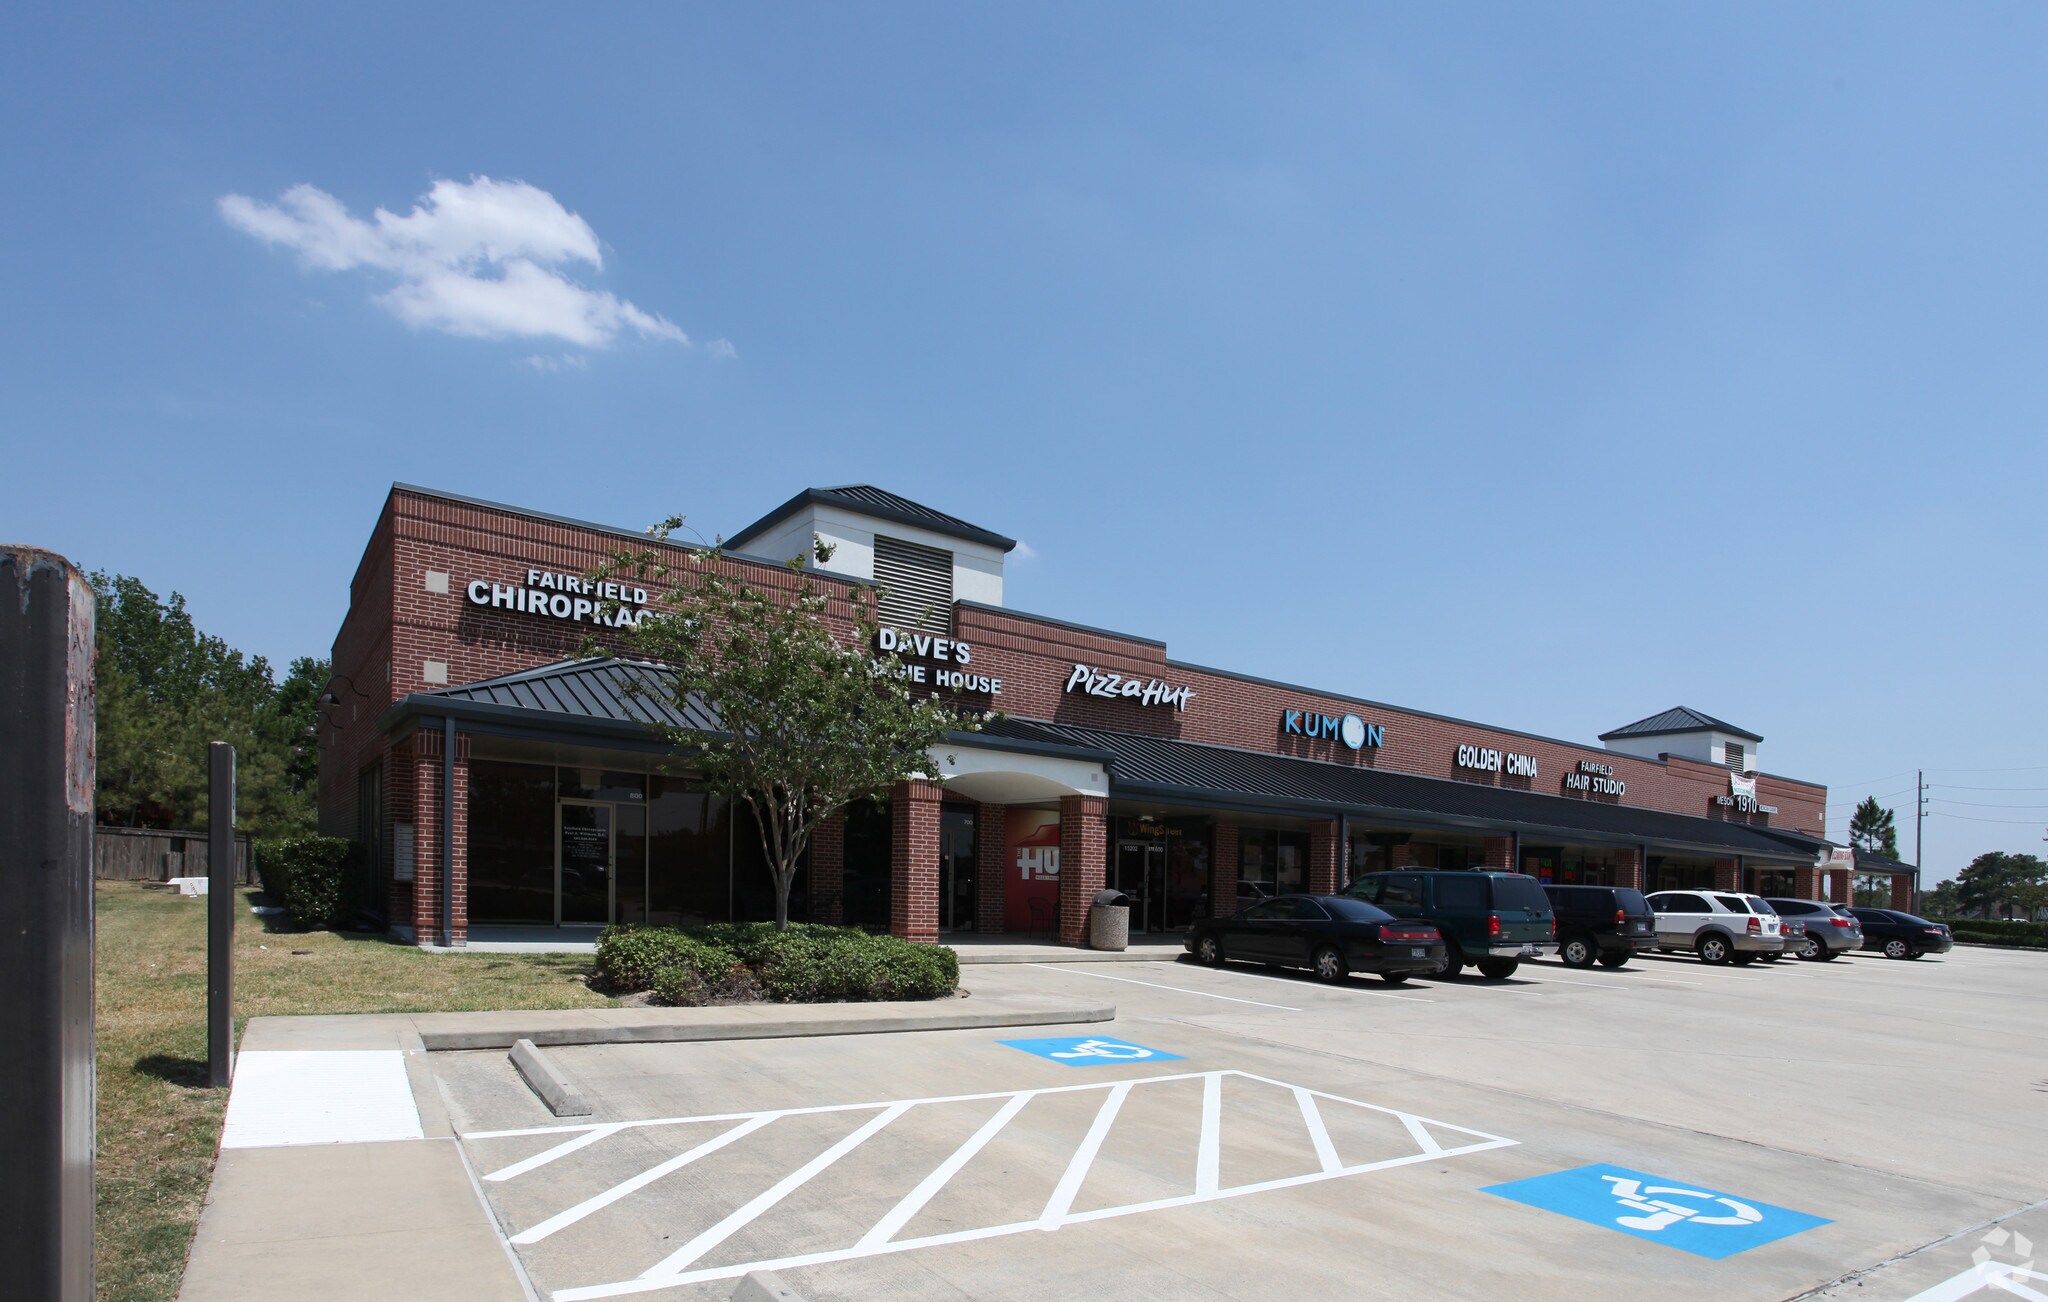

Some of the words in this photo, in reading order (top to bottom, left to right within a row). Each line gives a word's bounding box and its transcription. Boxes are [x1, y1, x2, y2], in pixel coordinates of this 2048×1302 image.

[526, 569, 648, 604] FAIRFIELD
[879, 627, 971, 664] DAVE'S
[936, 669, 1002, 695] HOUSE
[1285, 710, 1385, 749] KUMON
[1457, 744, 1502, 772] GOLDEN
[1507, 752, 1537, 777] CHINA
[1581, 761, 1613, 776] FAIRFIELD
[1567, 773, 1589, 791] HAIR
[1593, 777, 1625, 796] STUDIO
[1737, 796, 1757, 813] 1910
